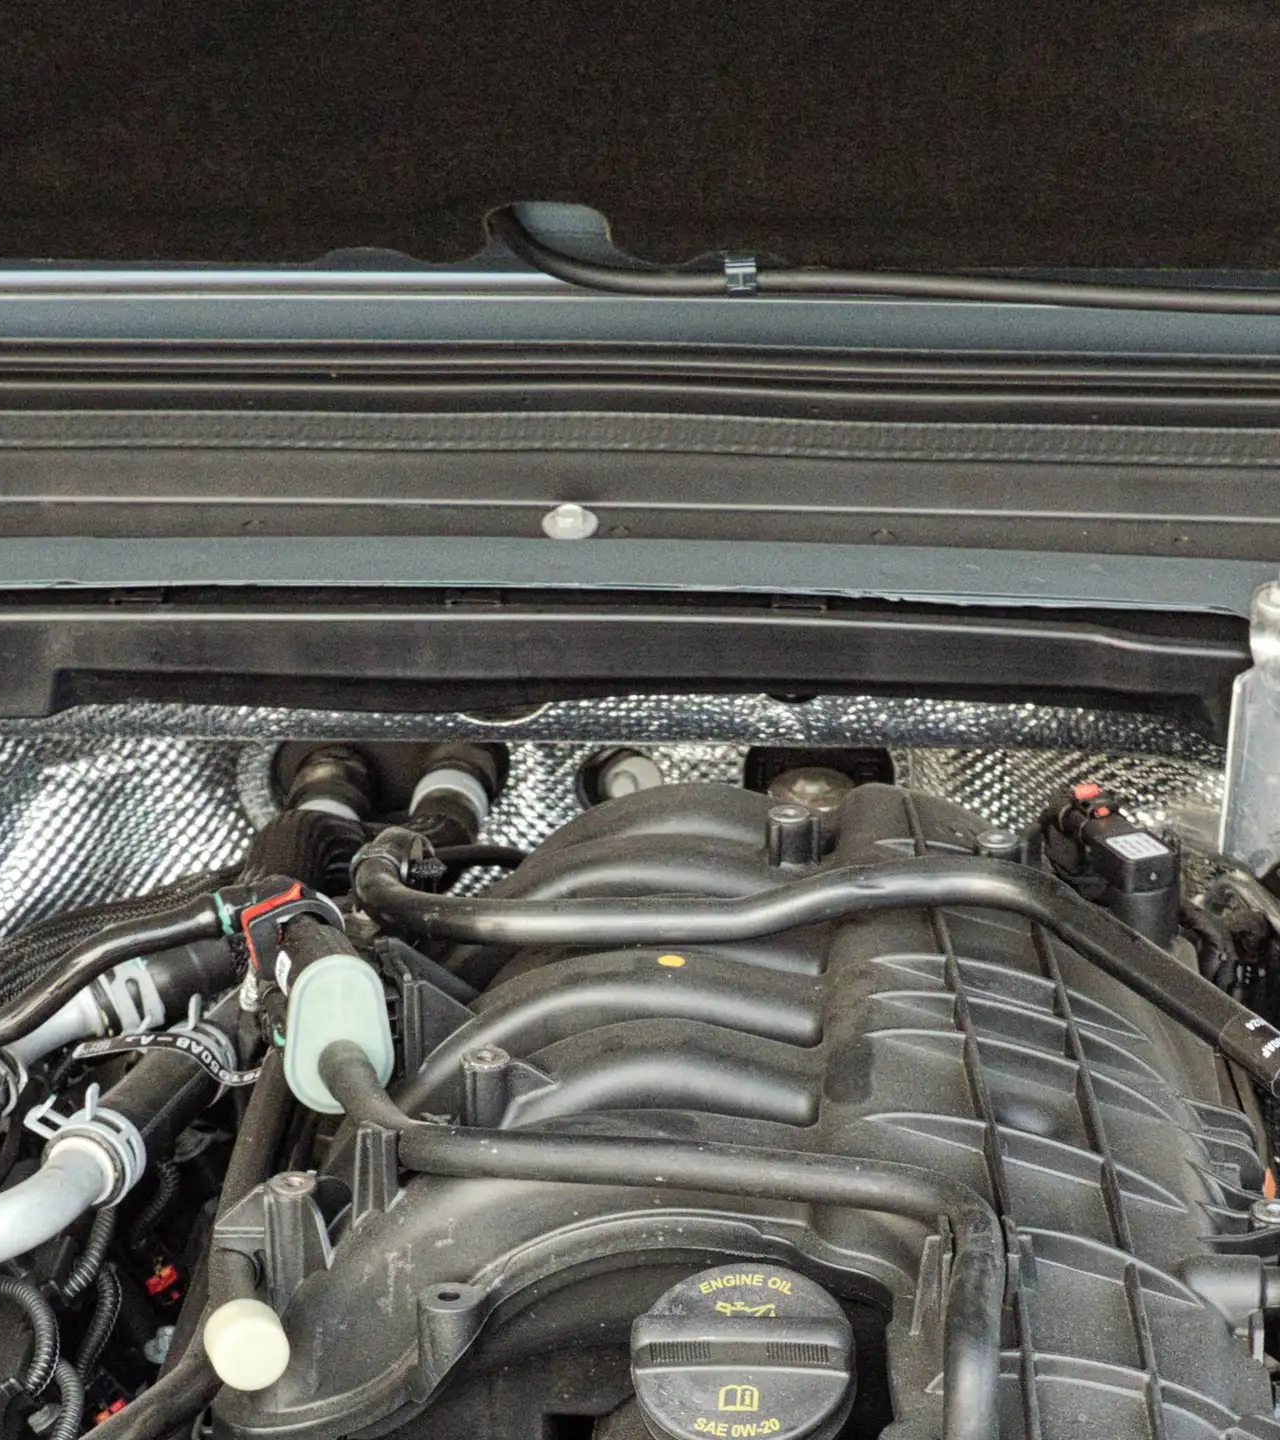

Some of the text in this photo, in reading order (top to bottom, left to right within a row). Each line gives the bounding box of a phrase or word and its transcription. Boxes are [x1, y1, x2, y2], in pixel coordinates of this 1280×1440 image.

[698, 1274, 793, 1296] ENGINE OIL
[693, 1417, 781, 1438] SAE 0W-20
